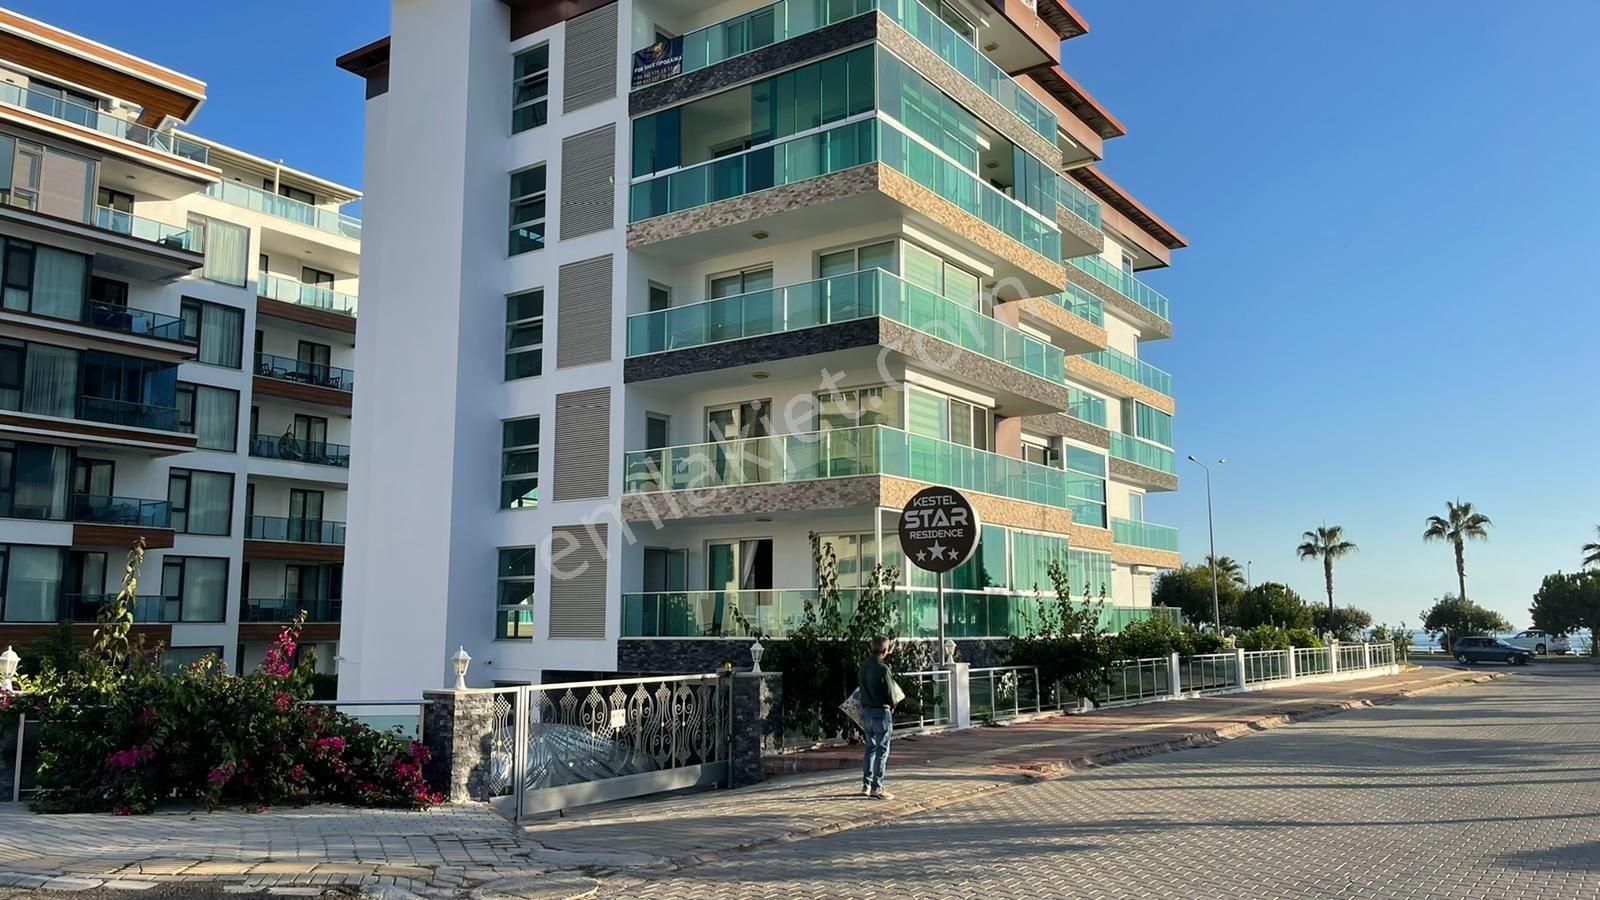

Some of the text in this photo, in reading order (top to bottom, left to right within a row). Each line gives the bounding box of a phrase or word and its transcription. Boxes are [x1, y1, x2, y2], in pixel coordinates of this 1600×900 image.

[913, 495, 957, 507] KESTEL
[904, 507, 968, 529] STAR
[910, 528, 964, 540] RESIDENCE
